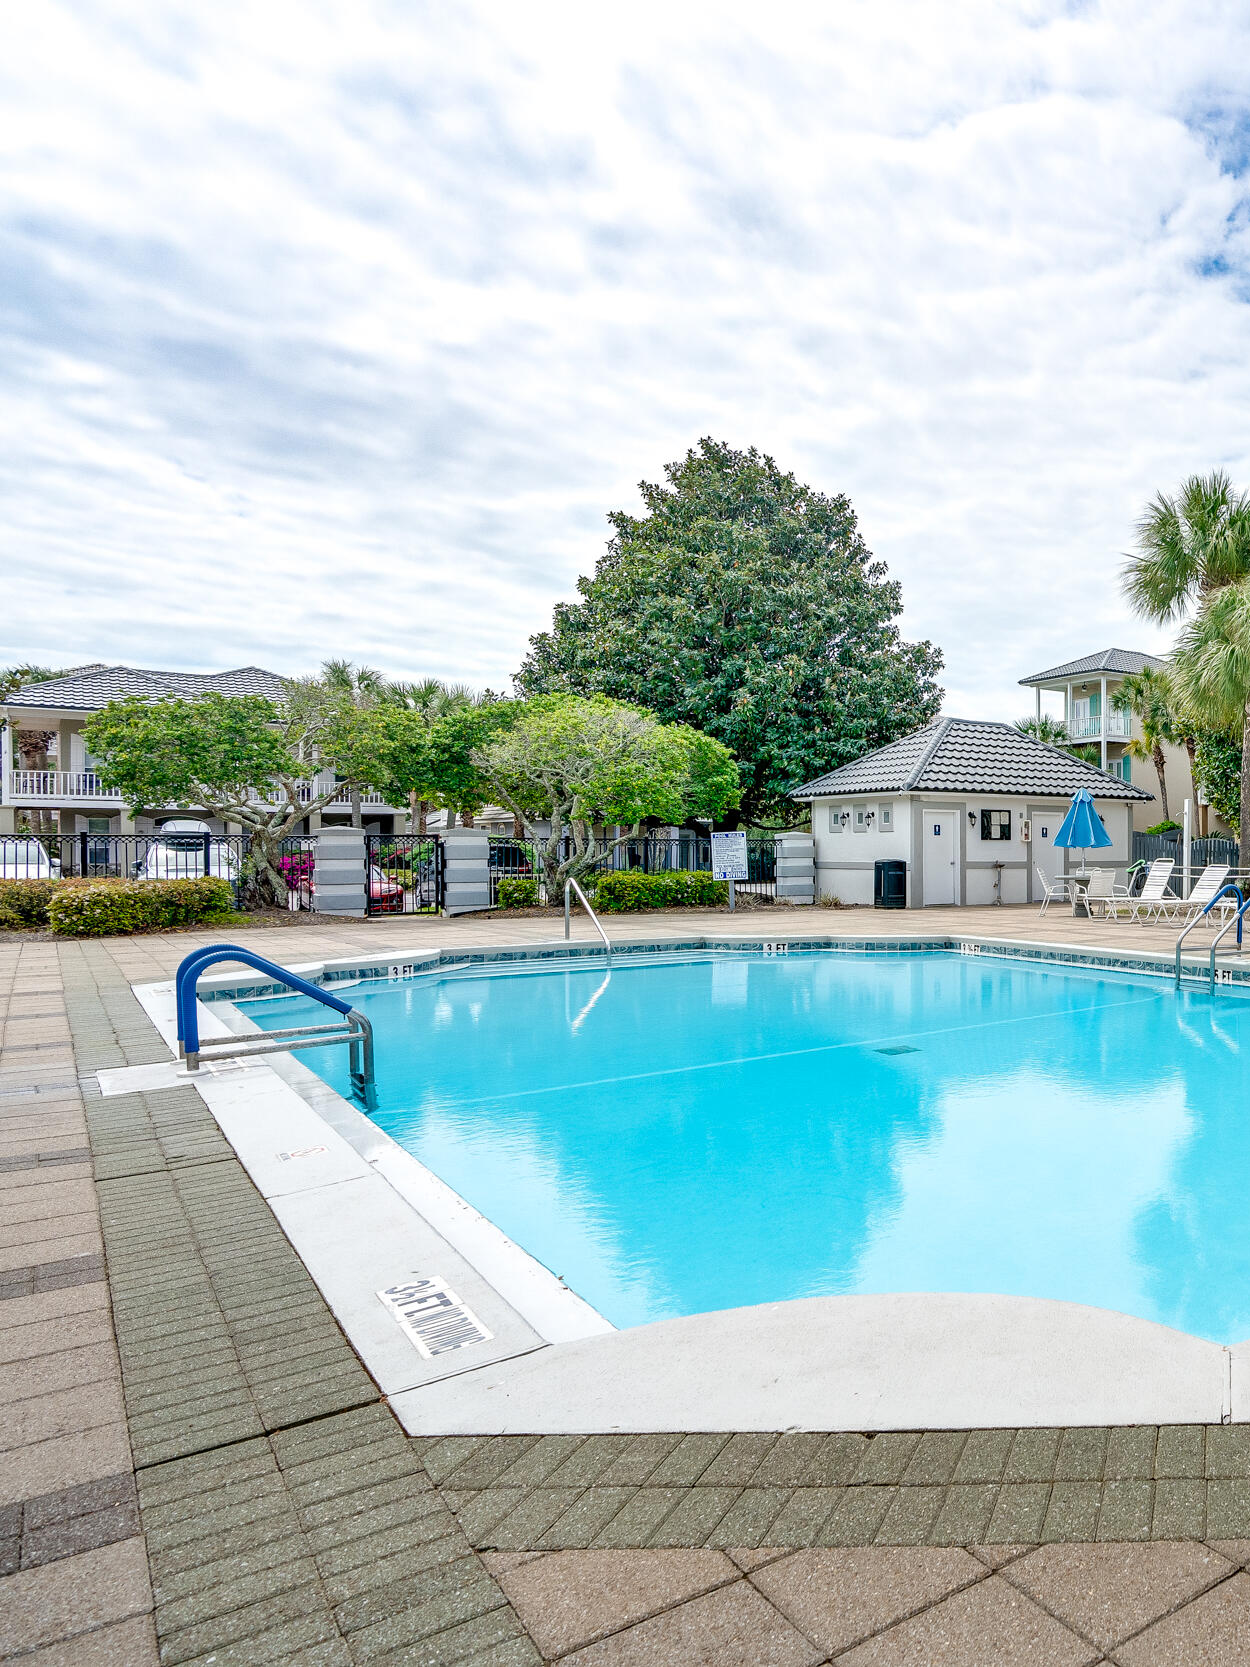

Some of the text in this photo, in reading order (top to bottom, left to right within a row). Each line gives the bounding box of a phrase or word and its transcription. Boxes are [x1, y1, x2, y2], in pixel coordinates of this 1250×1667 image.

[1222, 970, 1231, 980] FT
[407, 1307, 465, 1329] NO
[416, 1317, 486, 1356] DIVING
